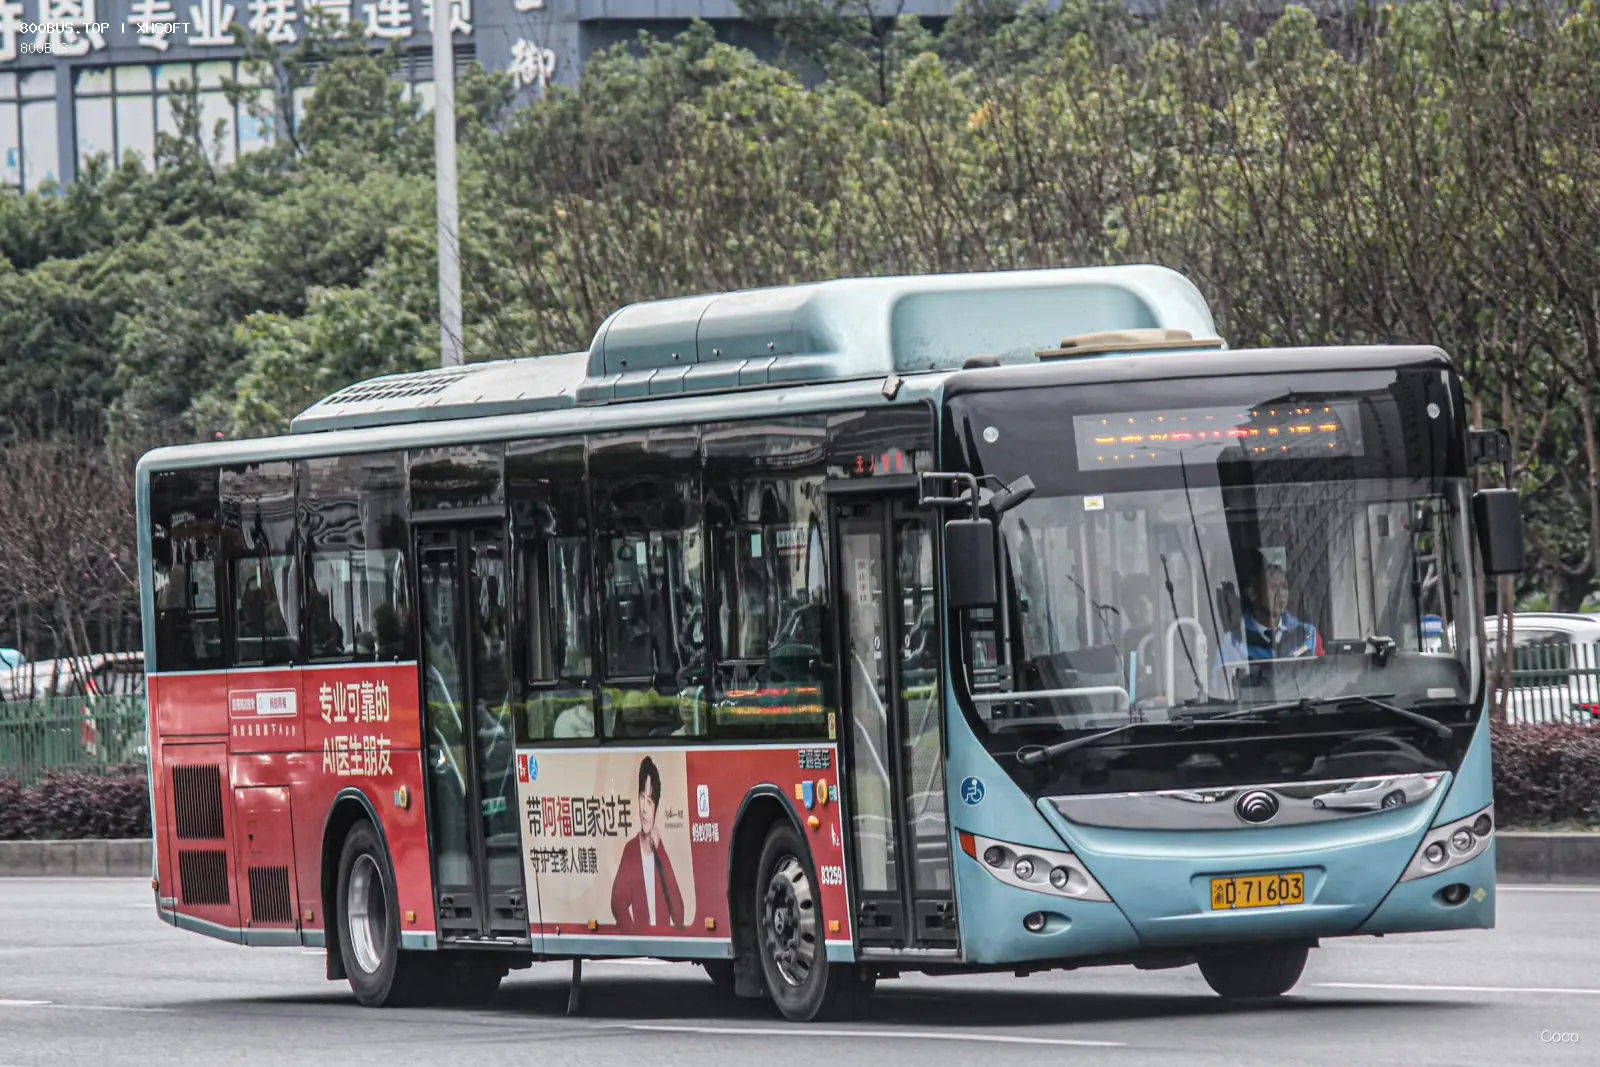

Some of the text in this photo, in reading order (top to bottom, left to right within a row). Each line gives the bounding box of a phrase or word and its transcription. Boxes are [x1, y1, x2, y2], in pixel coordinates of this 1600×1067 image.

[318, 680, 390, 724] 专业可靠的
[322, 733, 394, 777] AI医生朋友
[526, 794, 633, 838] 带阿福回家过年
[529, 846, 599, 875] 守护全家人健康
[820, 865, 843, 885] 83259
